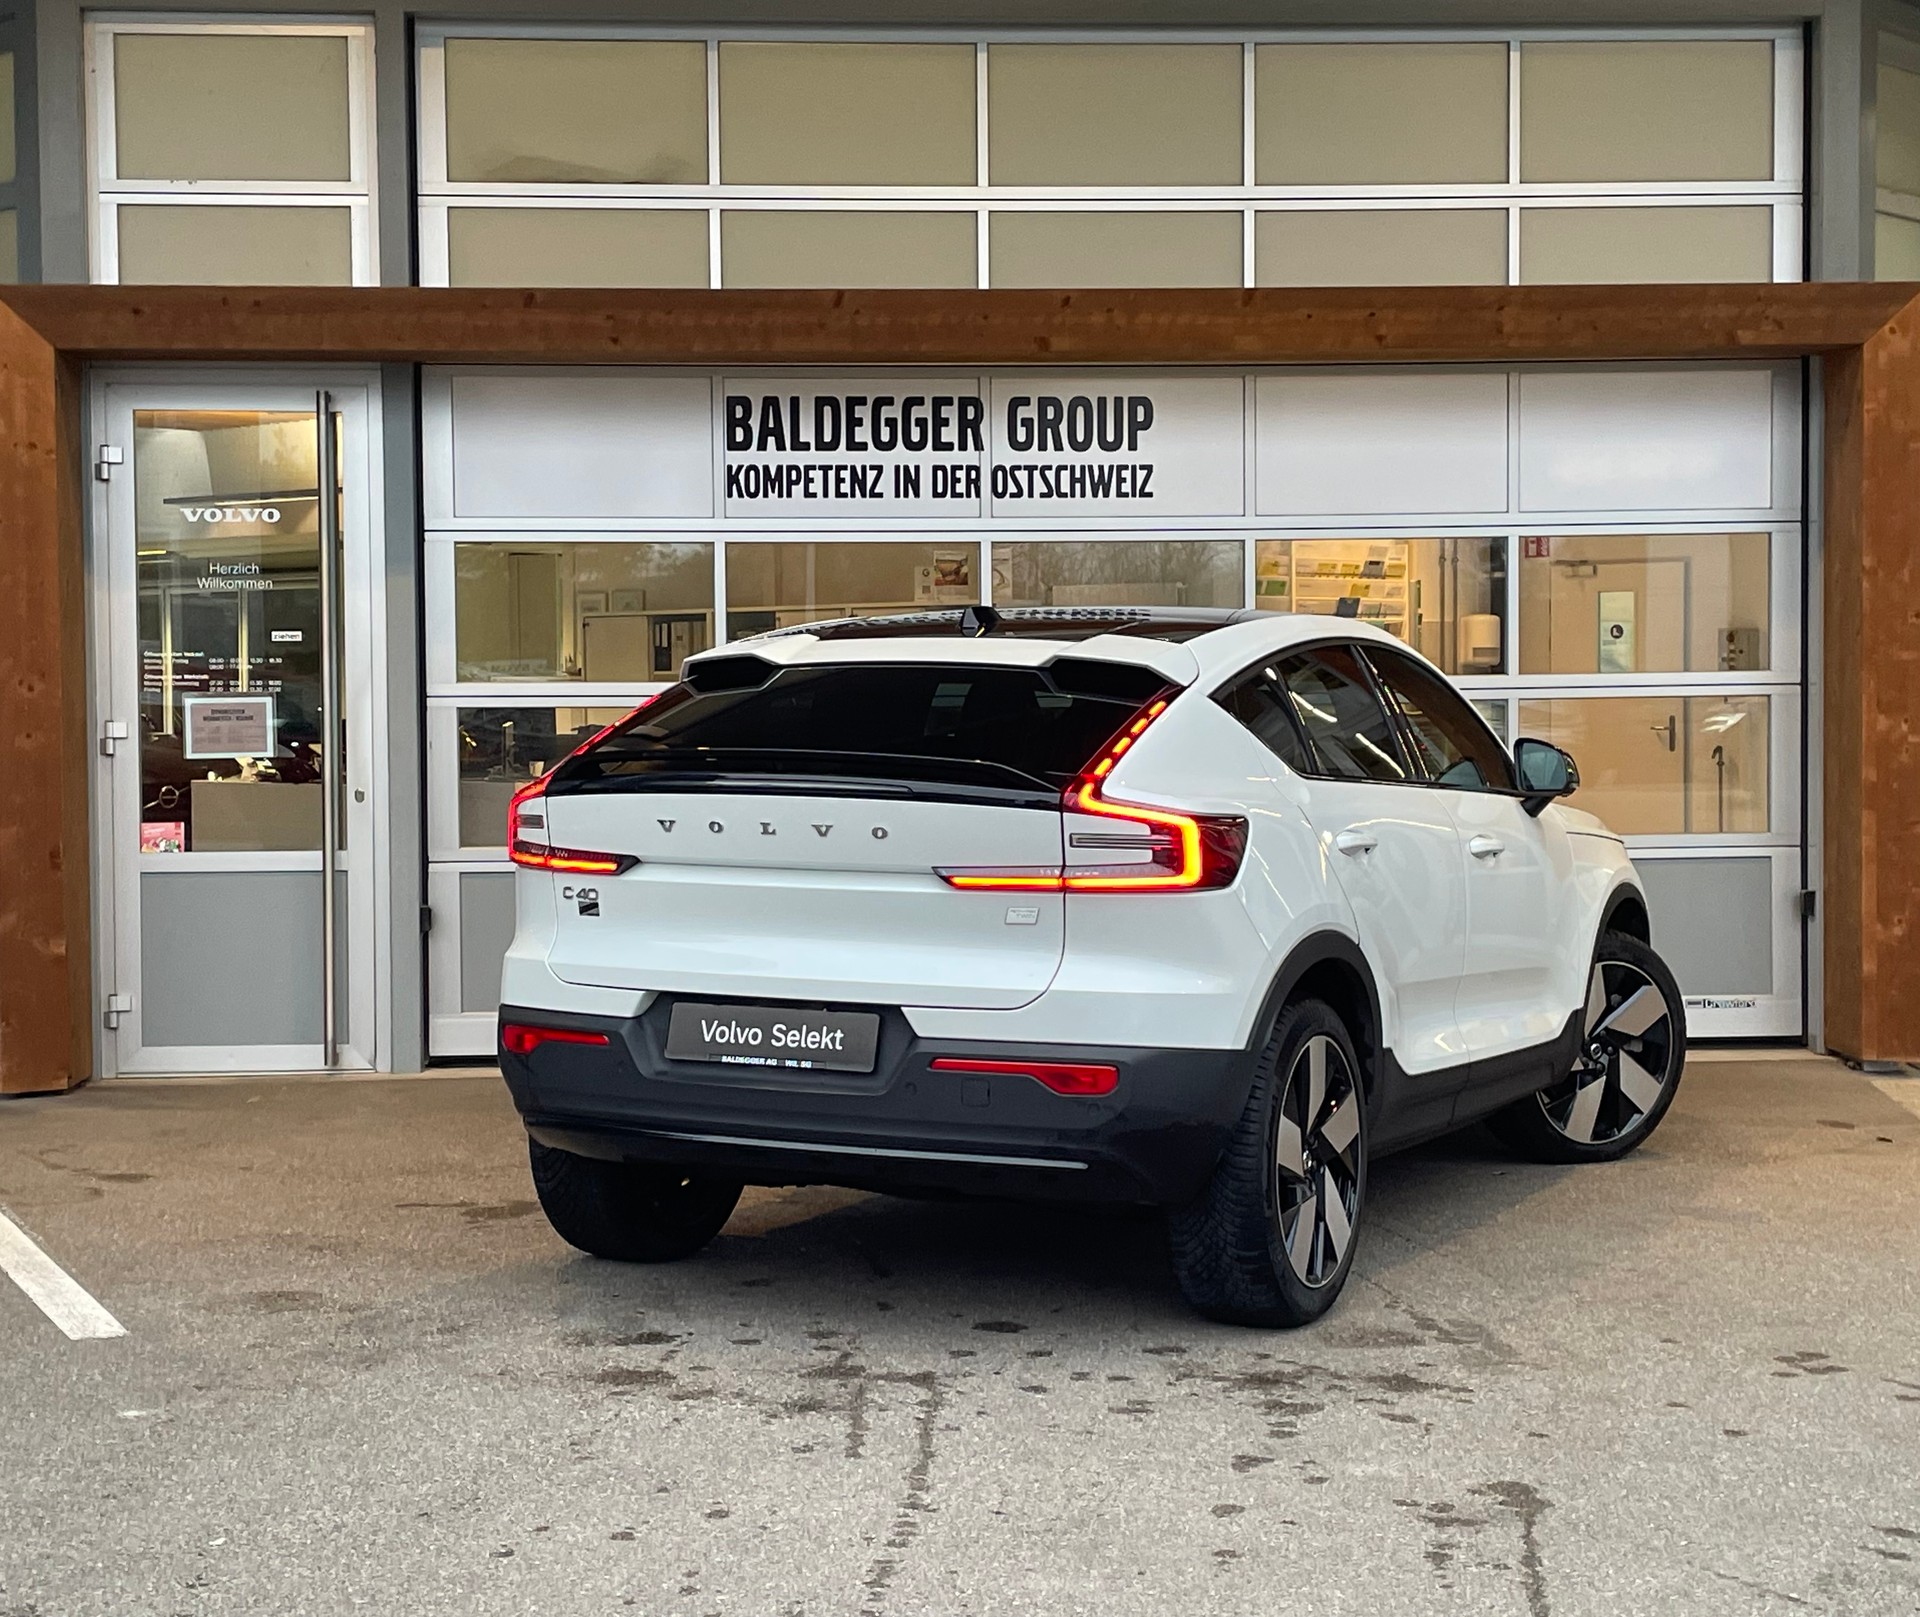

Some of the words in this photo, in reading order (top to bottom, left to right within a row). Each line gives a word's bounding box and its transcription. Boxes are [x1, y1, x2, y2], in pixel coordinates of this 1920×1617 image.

[726, 396, 985, 452] BALDEGGER
[1007, 396, 1154, 452] GROUP
[727, 464, 884, 499] KOMPETENZ
[894, 464, 920, 499] IN
[932, 464, 981, 499] DER
[991, 464, 1154, 499] OSTSCHWEIZ
[180, 508, 281, 523] VOLVO
[209, 562, 260, 575] Herzlich
[196, 577, 274, 590] Willkommen
[273, 632, 300, 640] ziehen
[657, 819, 888, 840] VOLVO
[563, 886, 599, 901] C40
[701, 1019, 763, 1046] Volvo
[771, 1023, 844, 1051] Selekt
[765, 1057, 778, 1066] AG
